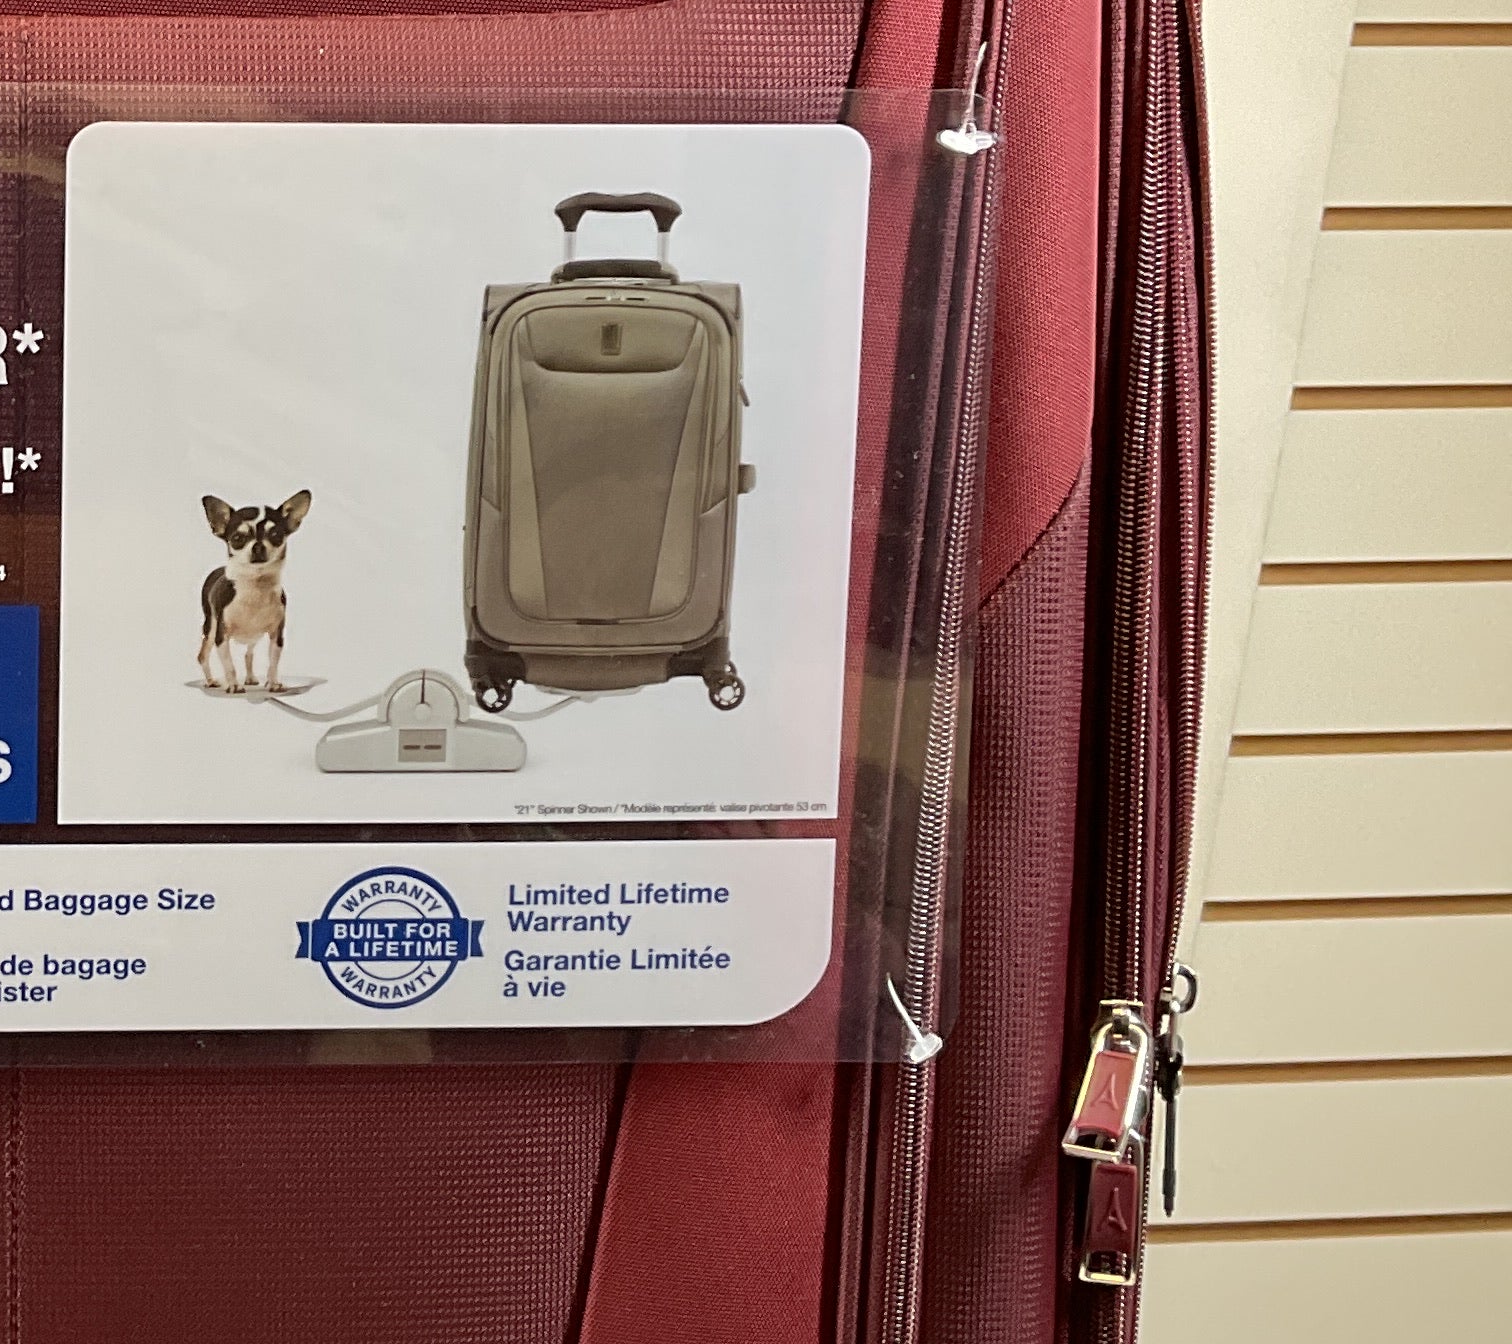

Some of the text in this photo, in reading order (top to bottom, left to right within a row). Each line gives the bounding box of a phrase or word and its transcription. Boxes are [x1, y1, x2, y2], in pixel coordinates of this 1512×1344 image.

[23, 888, 149, 915] Baggage
[156, 887, 216, 910] Size
[340, 880, 441, 913] WARRANTY
[508, 882, 729, 905] Limited Lifetime
[333, 922, 450, 939] BUILT FOR
[507, 911, 631, 935] Warranty
[324, 940, 458, 957] A LIFETIME
[504, 945, 730, 971] Garantie Limitée
[0, 954, 33, 976] de
[42, 954, 146, 979] bagage
[340, 965, 436, 998] WARRANTY
[503, 974, 566, 997] à vie
